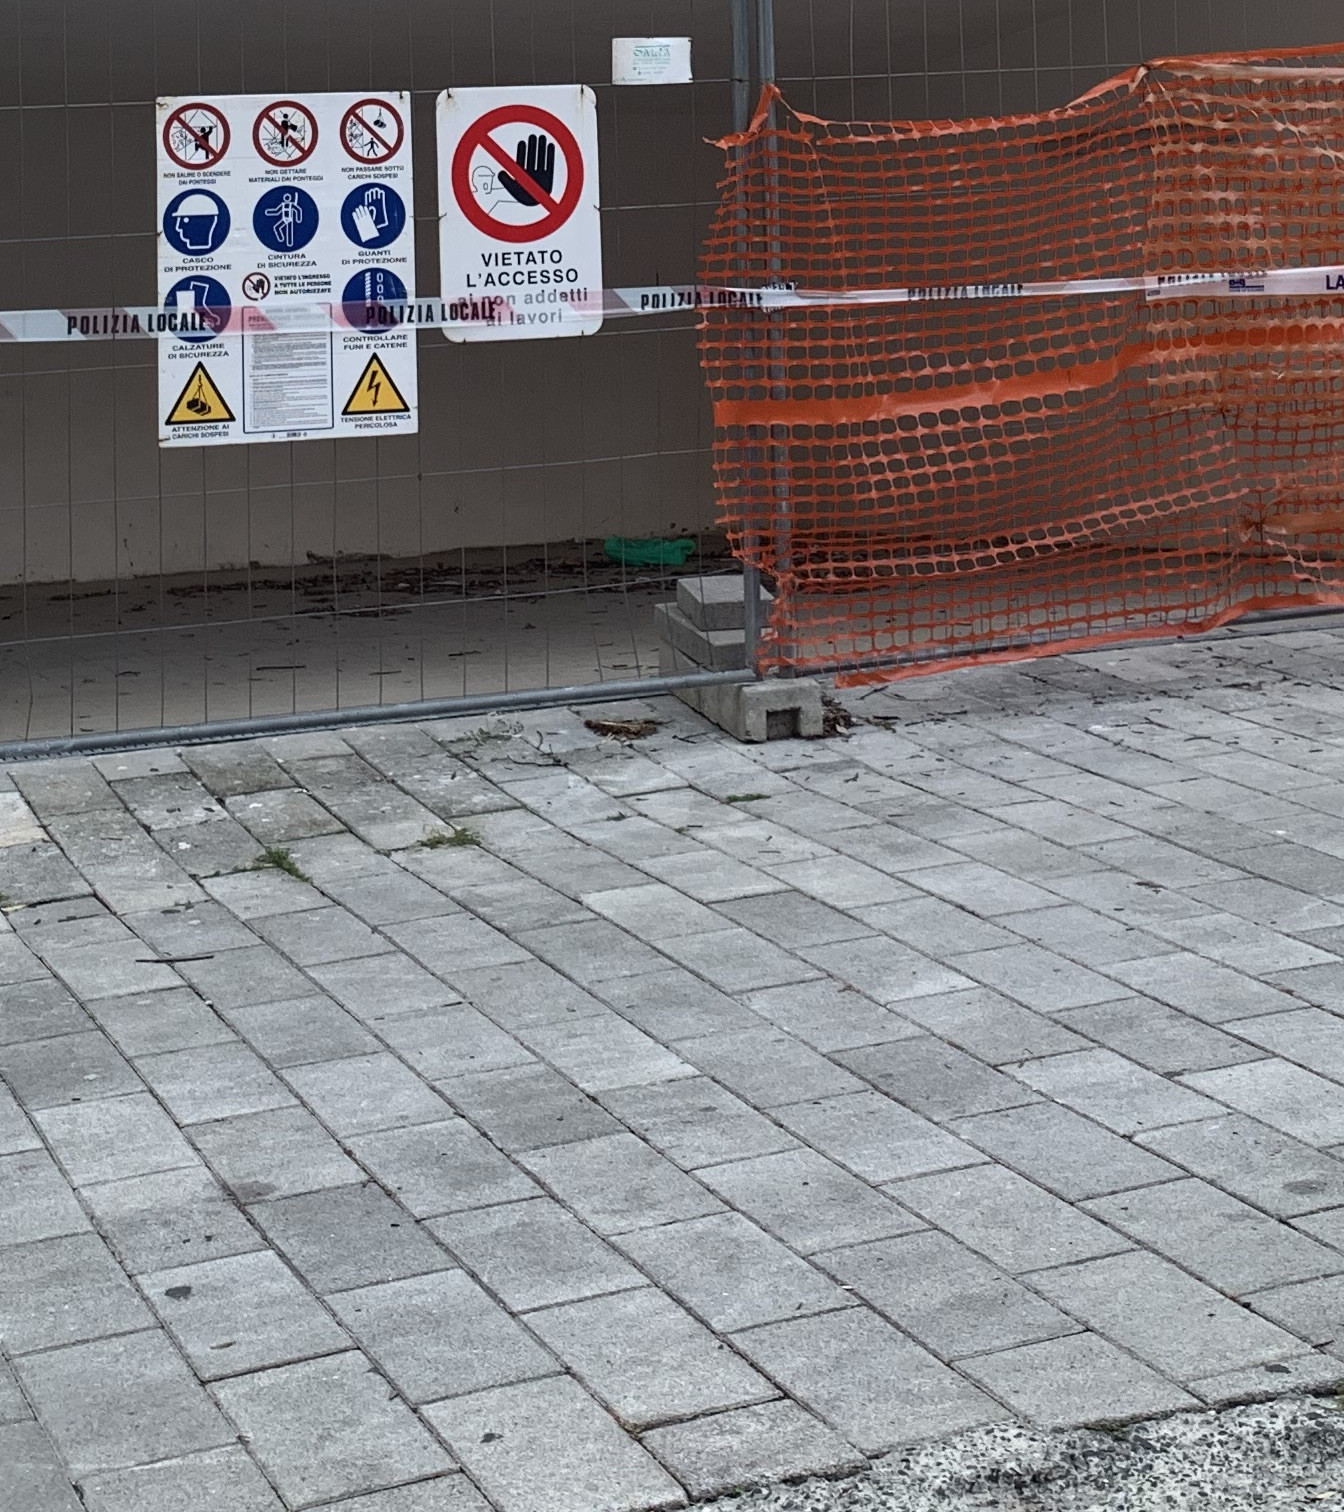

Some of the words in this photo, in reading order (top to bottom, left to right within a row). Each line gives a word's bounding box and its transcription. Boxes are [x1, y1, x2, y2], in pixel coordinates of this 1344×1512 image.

[268, 260, 317, 268] SICUREZZA
[481, 249, 562, 267] VIETATO
[175, 264, 232, 272] PROTEZIONE
[466, 268, 578, 288] L'ACCESSO
[482, 293, 516, 307] non
[524, 287, 588, 305] addetti
[641, 292, 702, 310] POLIZIA
[366, 304, 434, 325] POLIZIA
[441, 301, 496, 322] LOCALE
[510, 308, 562, 325] lavori
[67, 313, 140, 335] POLIZIA
[147, 311, 206, 333] LOCALE
[172, 343, 224, 351] CALZATURE
[343, 334, 408, 343] CONTROLLARE
[179, 351, 229, 359] SICUREZZA
[341, 415, 373, 423] TENSIONE
